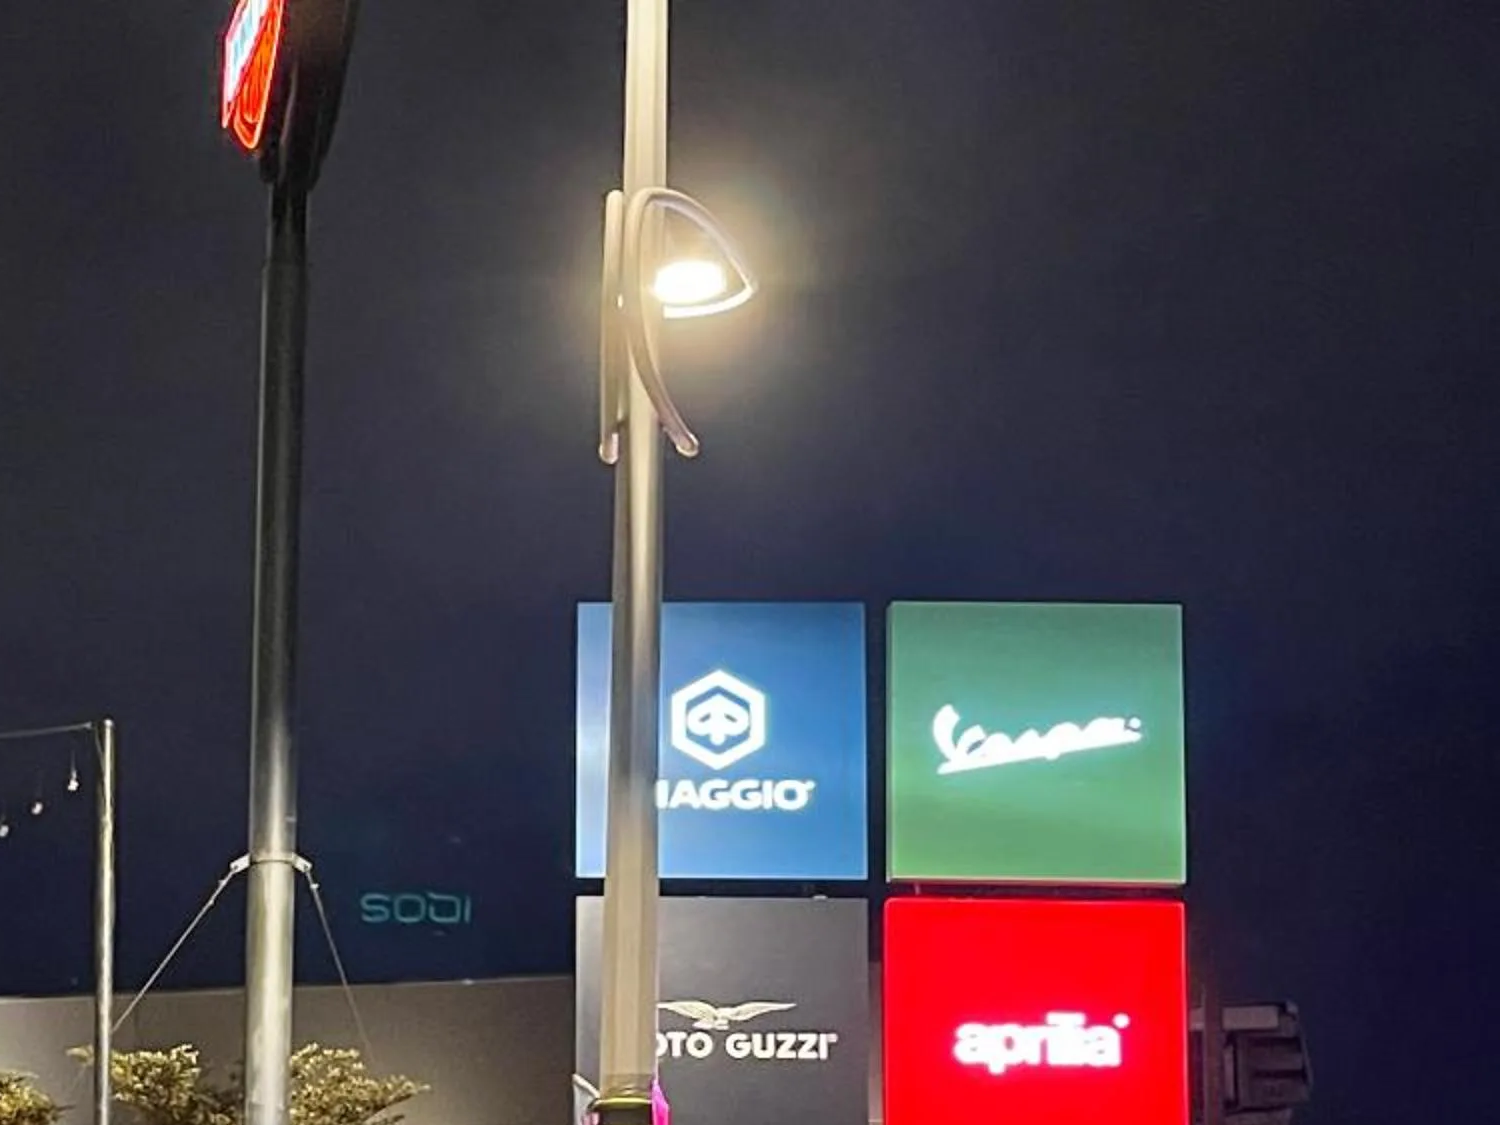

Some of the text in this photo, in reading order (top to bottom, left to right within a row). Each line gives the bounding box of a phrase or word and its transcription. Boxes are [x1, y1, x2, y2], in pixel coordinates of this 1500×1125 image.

[656, 778, 810, 811] IAGGIO
[725, 1031, 830, 1060] GUZZI
[952, 1012, 1124, 1075] aprilia
